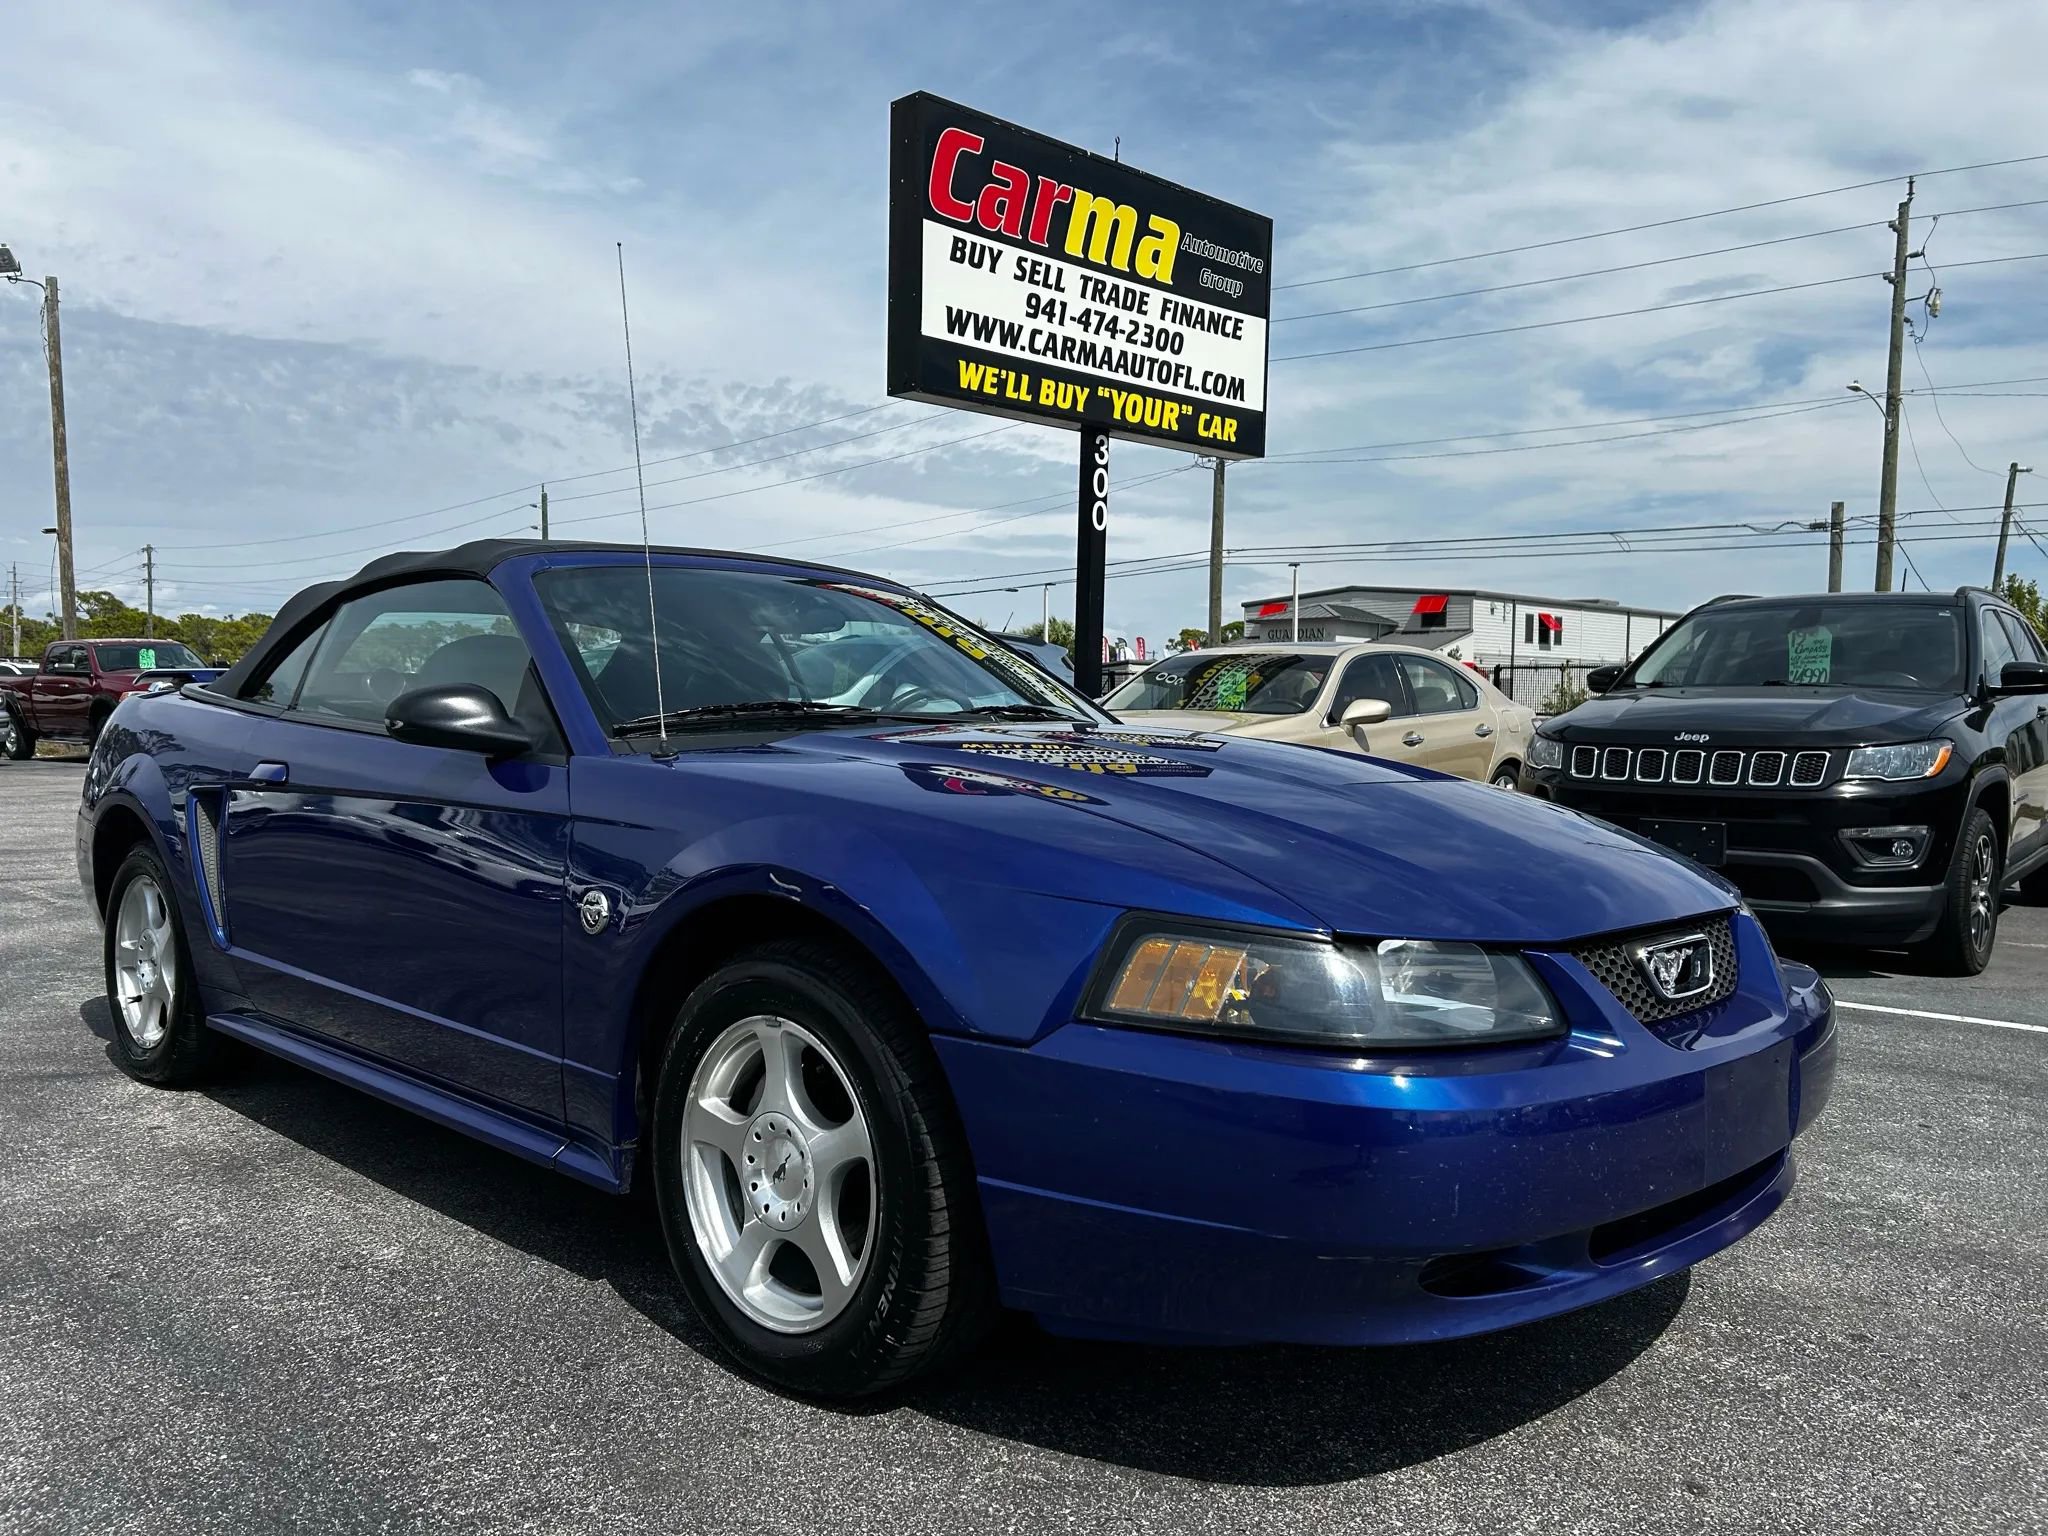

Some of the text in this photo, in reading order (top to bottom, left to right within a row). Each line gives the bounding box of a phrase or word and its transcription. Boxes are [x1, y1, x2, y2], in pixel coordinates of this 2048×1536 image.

[929, 127, 1182, 285] Carma
[949, 236, 1244, 340] BUY SELL TRADE FINANCE
[1181, 233, 1264, 275] Automotive
[1200, 268, 1244, 298] Group
[945, 305, 1245, 402] WWW.CARMAAUTOFL.COM
[1025, 293, 1184, 356] 941-474-2300
[958, 359, 1238, 443] WE'LL BUY "YOUR" CAR
[1092, 434, 1109, 531] 300
[1267, 627, 1326, 641] GUADIAN
[1674, 731, 1710, 743] Jeep
